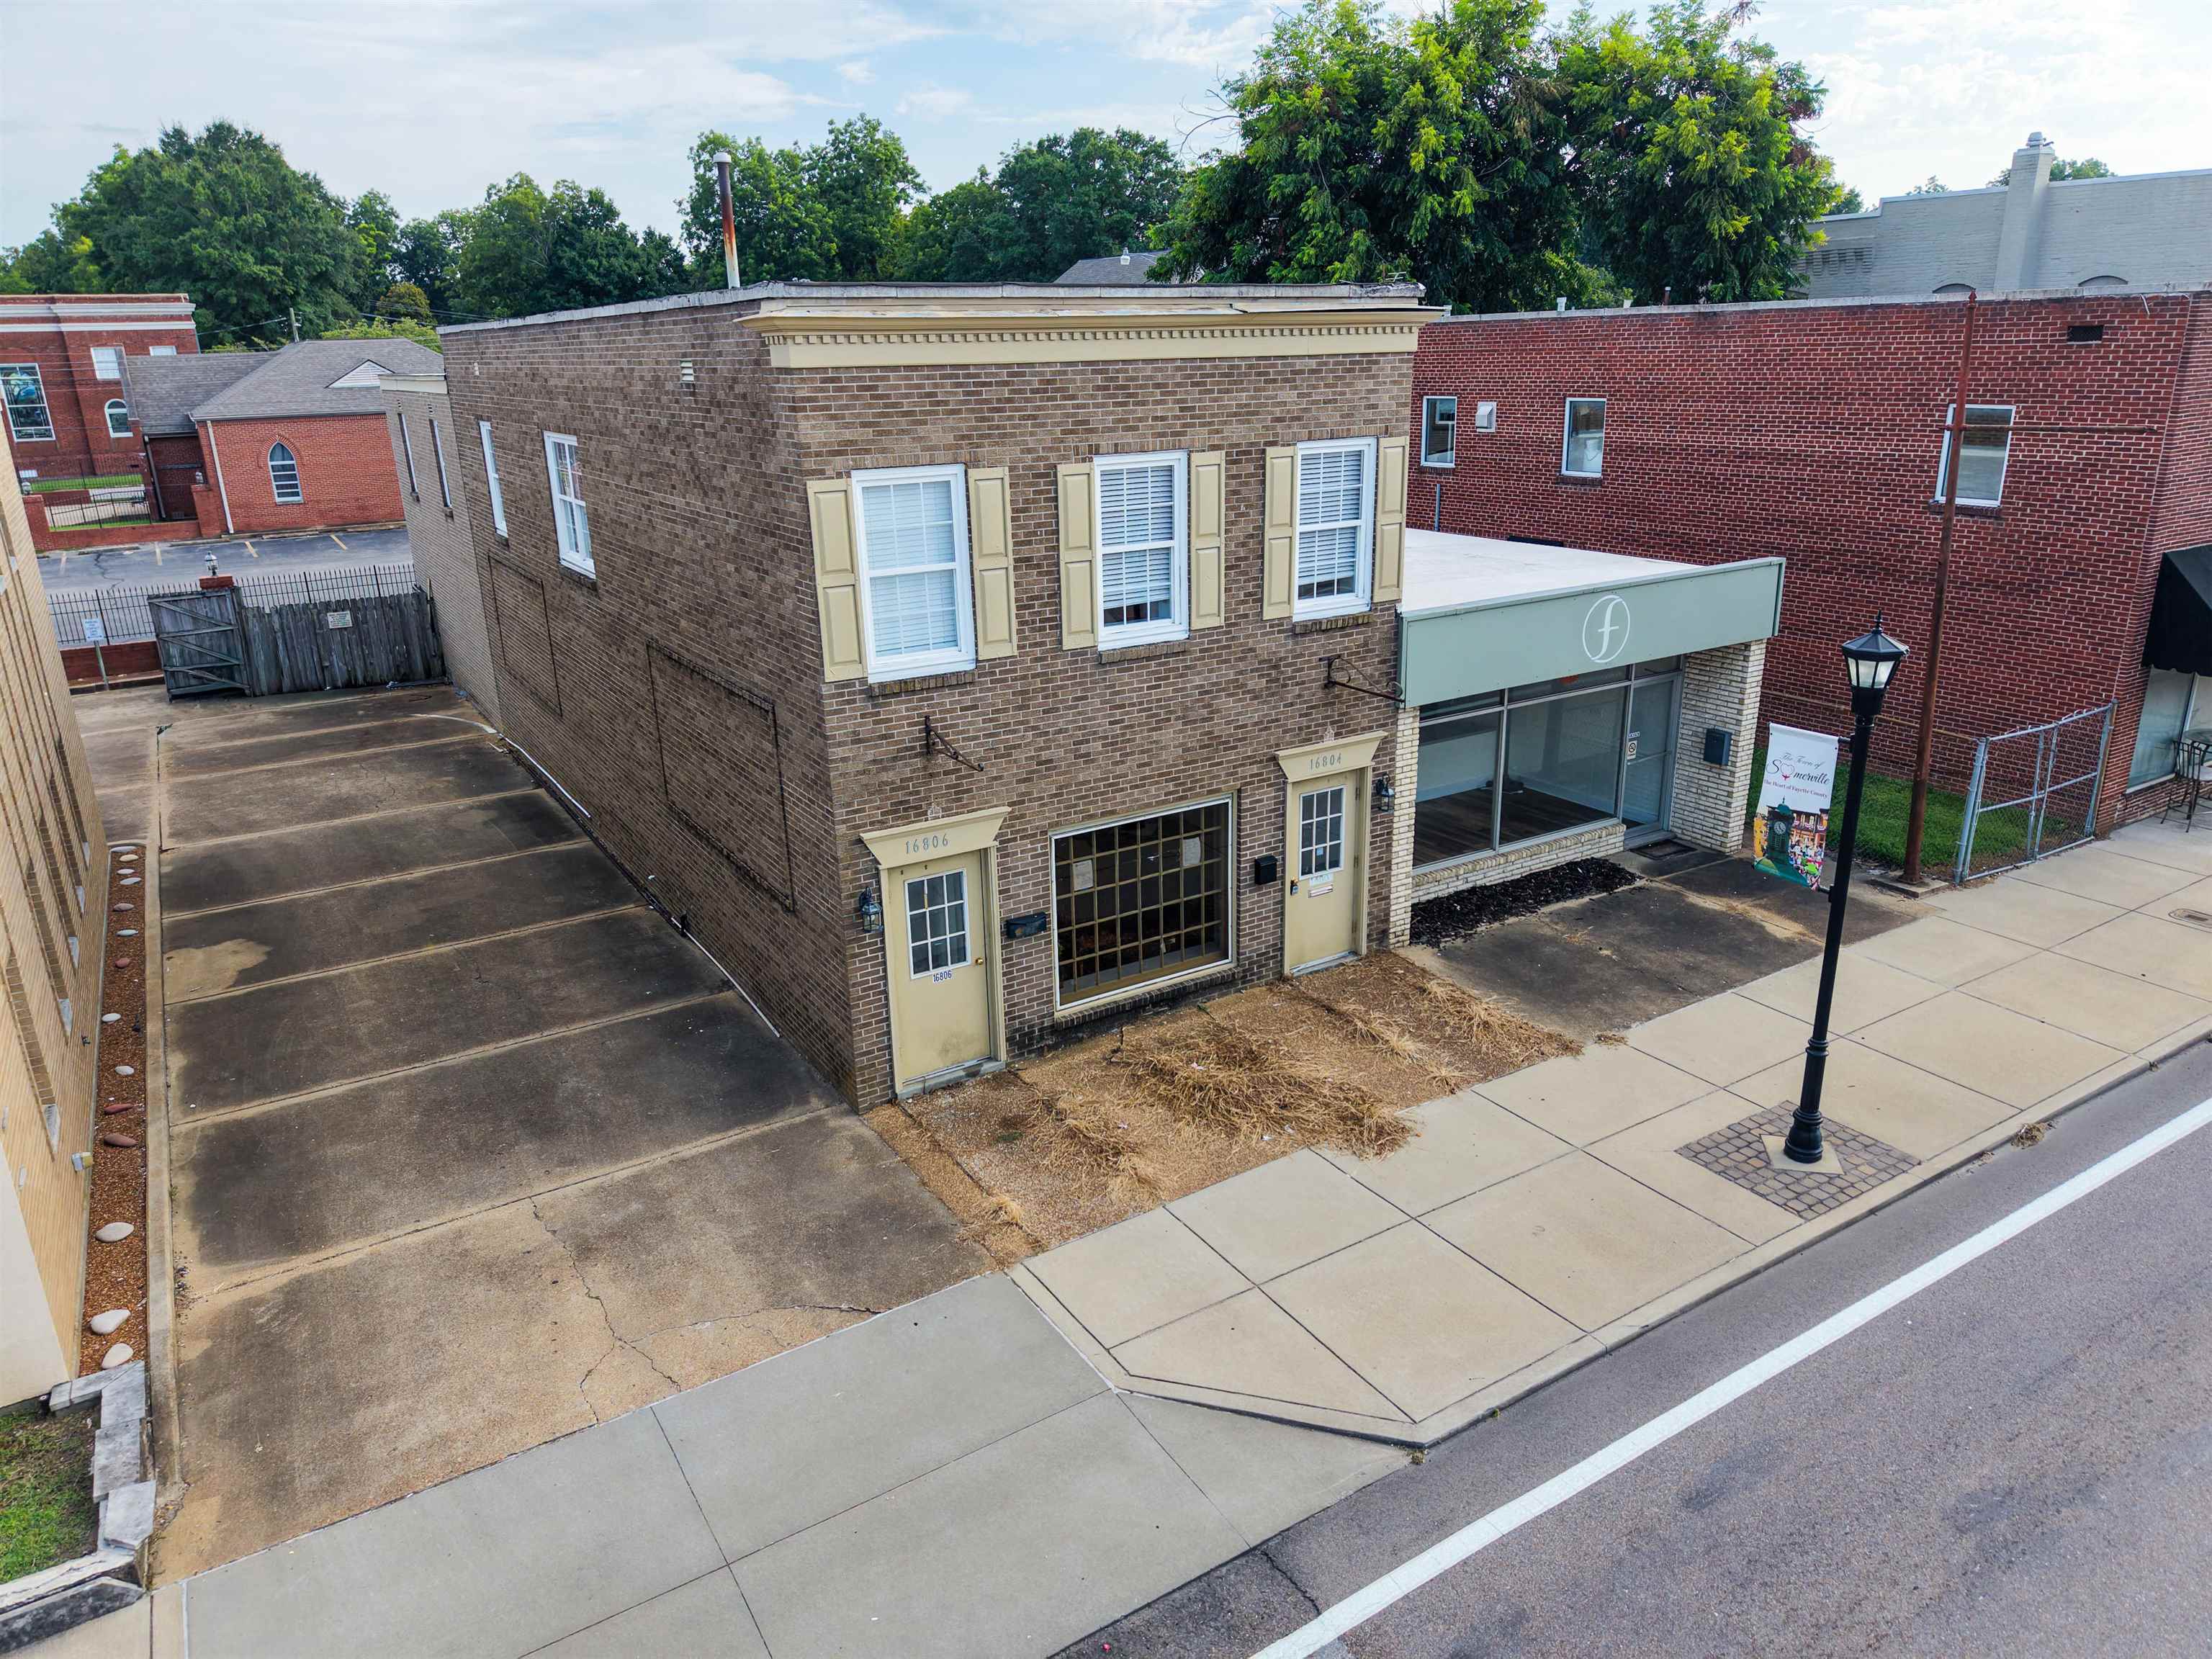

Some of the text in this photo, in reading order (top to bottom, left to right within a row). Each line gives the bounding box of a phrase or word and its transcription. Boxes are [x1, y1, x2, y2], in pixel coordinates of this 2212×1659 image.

[1310, 752, 1341, 770] 16804
[1779, 752, 1826, 770] The Town of
[1810, 790, 1827, 799] County
[906, 833, 948, 854] 16806
[933, 970, 952, 983] 16806
